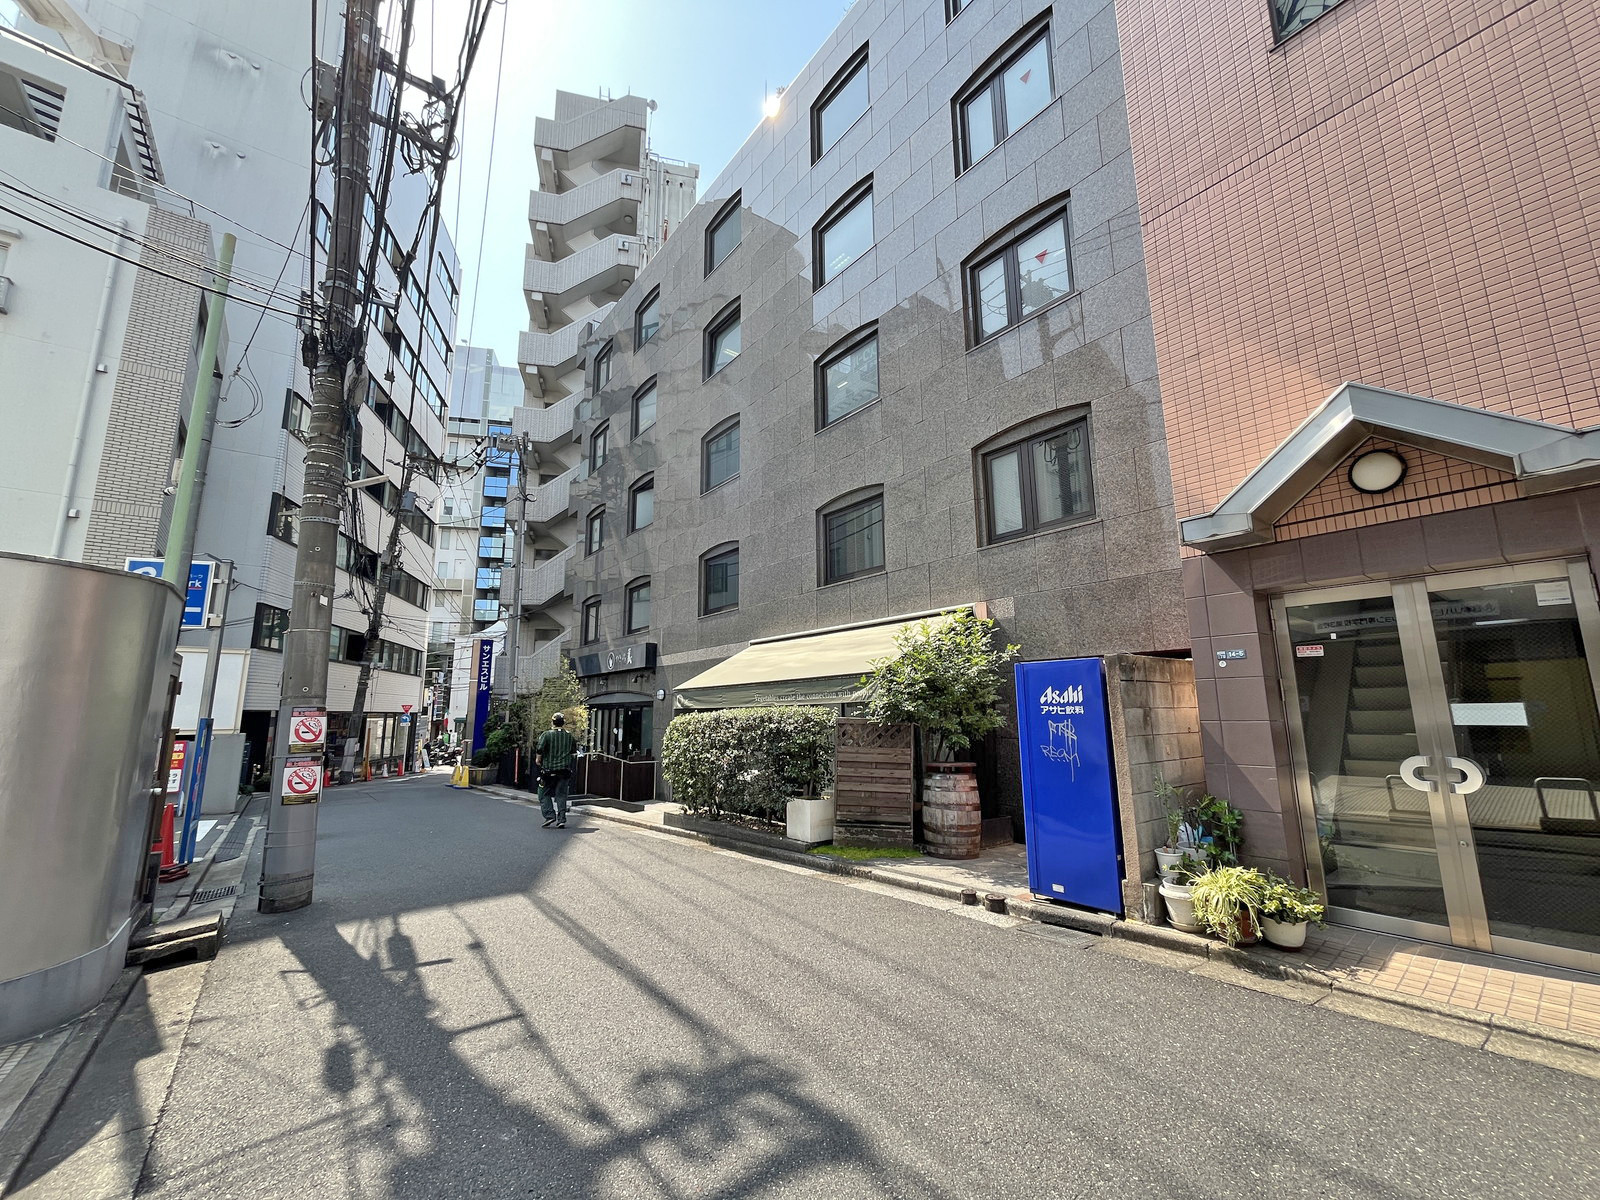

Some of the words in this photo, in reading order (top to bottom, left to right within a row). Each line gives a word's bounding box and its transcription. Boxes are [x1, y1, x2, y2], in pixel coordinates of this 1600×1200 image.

[479, 645, 491, 691] サンエスビル
[754, 694, 780, 702] Vegetables
[796, 692, 805, 700] the
[806, 690, 836, 700] connection
[838, 689, 851, 698] with
[1039, 684, 1084, 704] Asahi
[1040, 705, 1085, 715] アサヒ飲料
